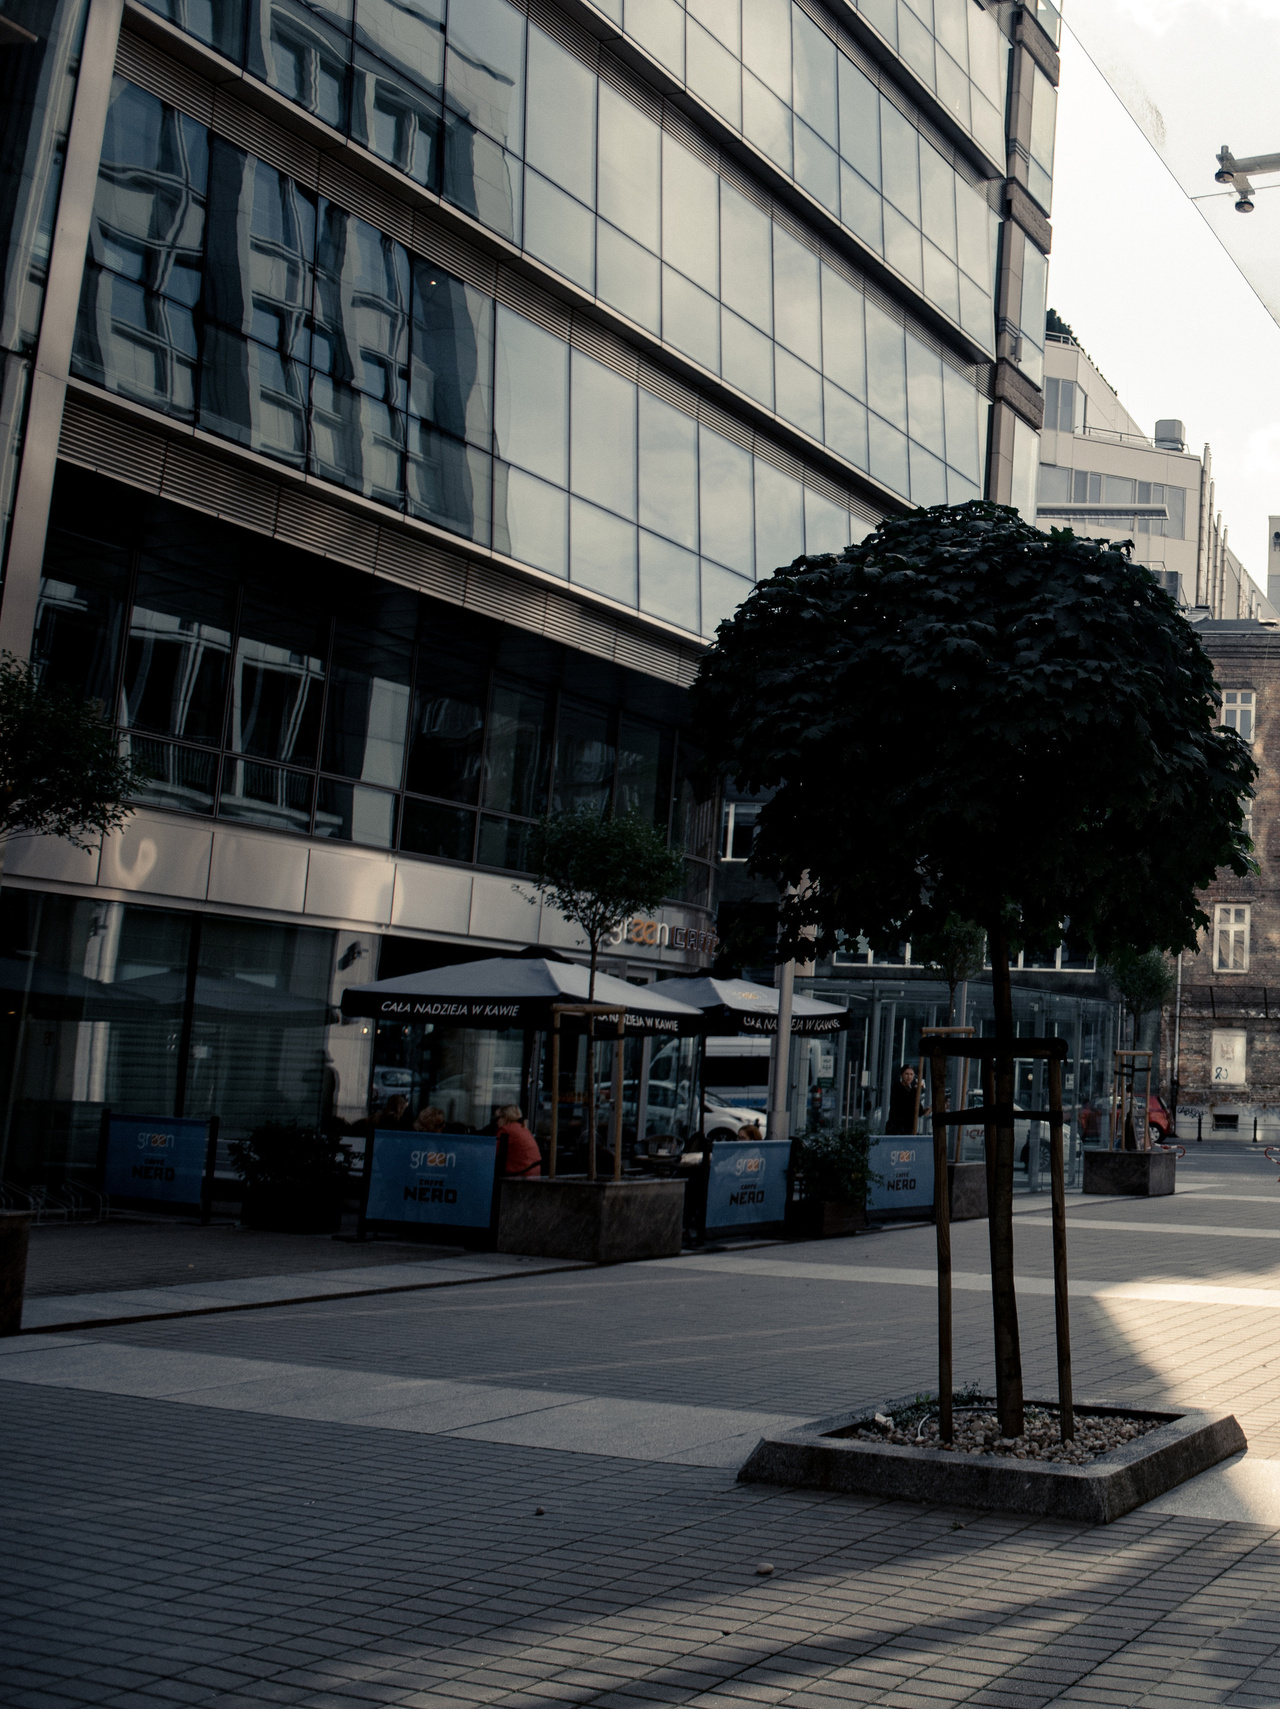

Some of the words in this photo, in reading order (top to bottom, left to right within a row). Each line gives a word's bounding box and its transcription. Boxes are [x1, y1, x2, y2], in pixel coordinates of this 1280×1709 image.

[609, 916, 670, 946] green
[380, 1001, 411, 1013] CAŁA
[414, 1002, 468, 1015] NADZIEJA
[471, 1004, 484, 1015] W
[484, 1004, 520, 1017] KAWIE
[645, 1016, 654, 1028] W
[654, 1017, 679, 1032] KAWIE
[805, 1018, 815, 1030] W
[137, 1132, 175, 1149] green
[409, 1150, 456, 1169] green
[890, 1149, 916, 1166] green
[131, 1165, 175, 1181] NERO
[735, 1157, 766, 1176] green
[887, 1178, 916, 1191] NERO
[403, 1185, 457, 1204] NERO
[729, 1190, 765, 1206] NERO
